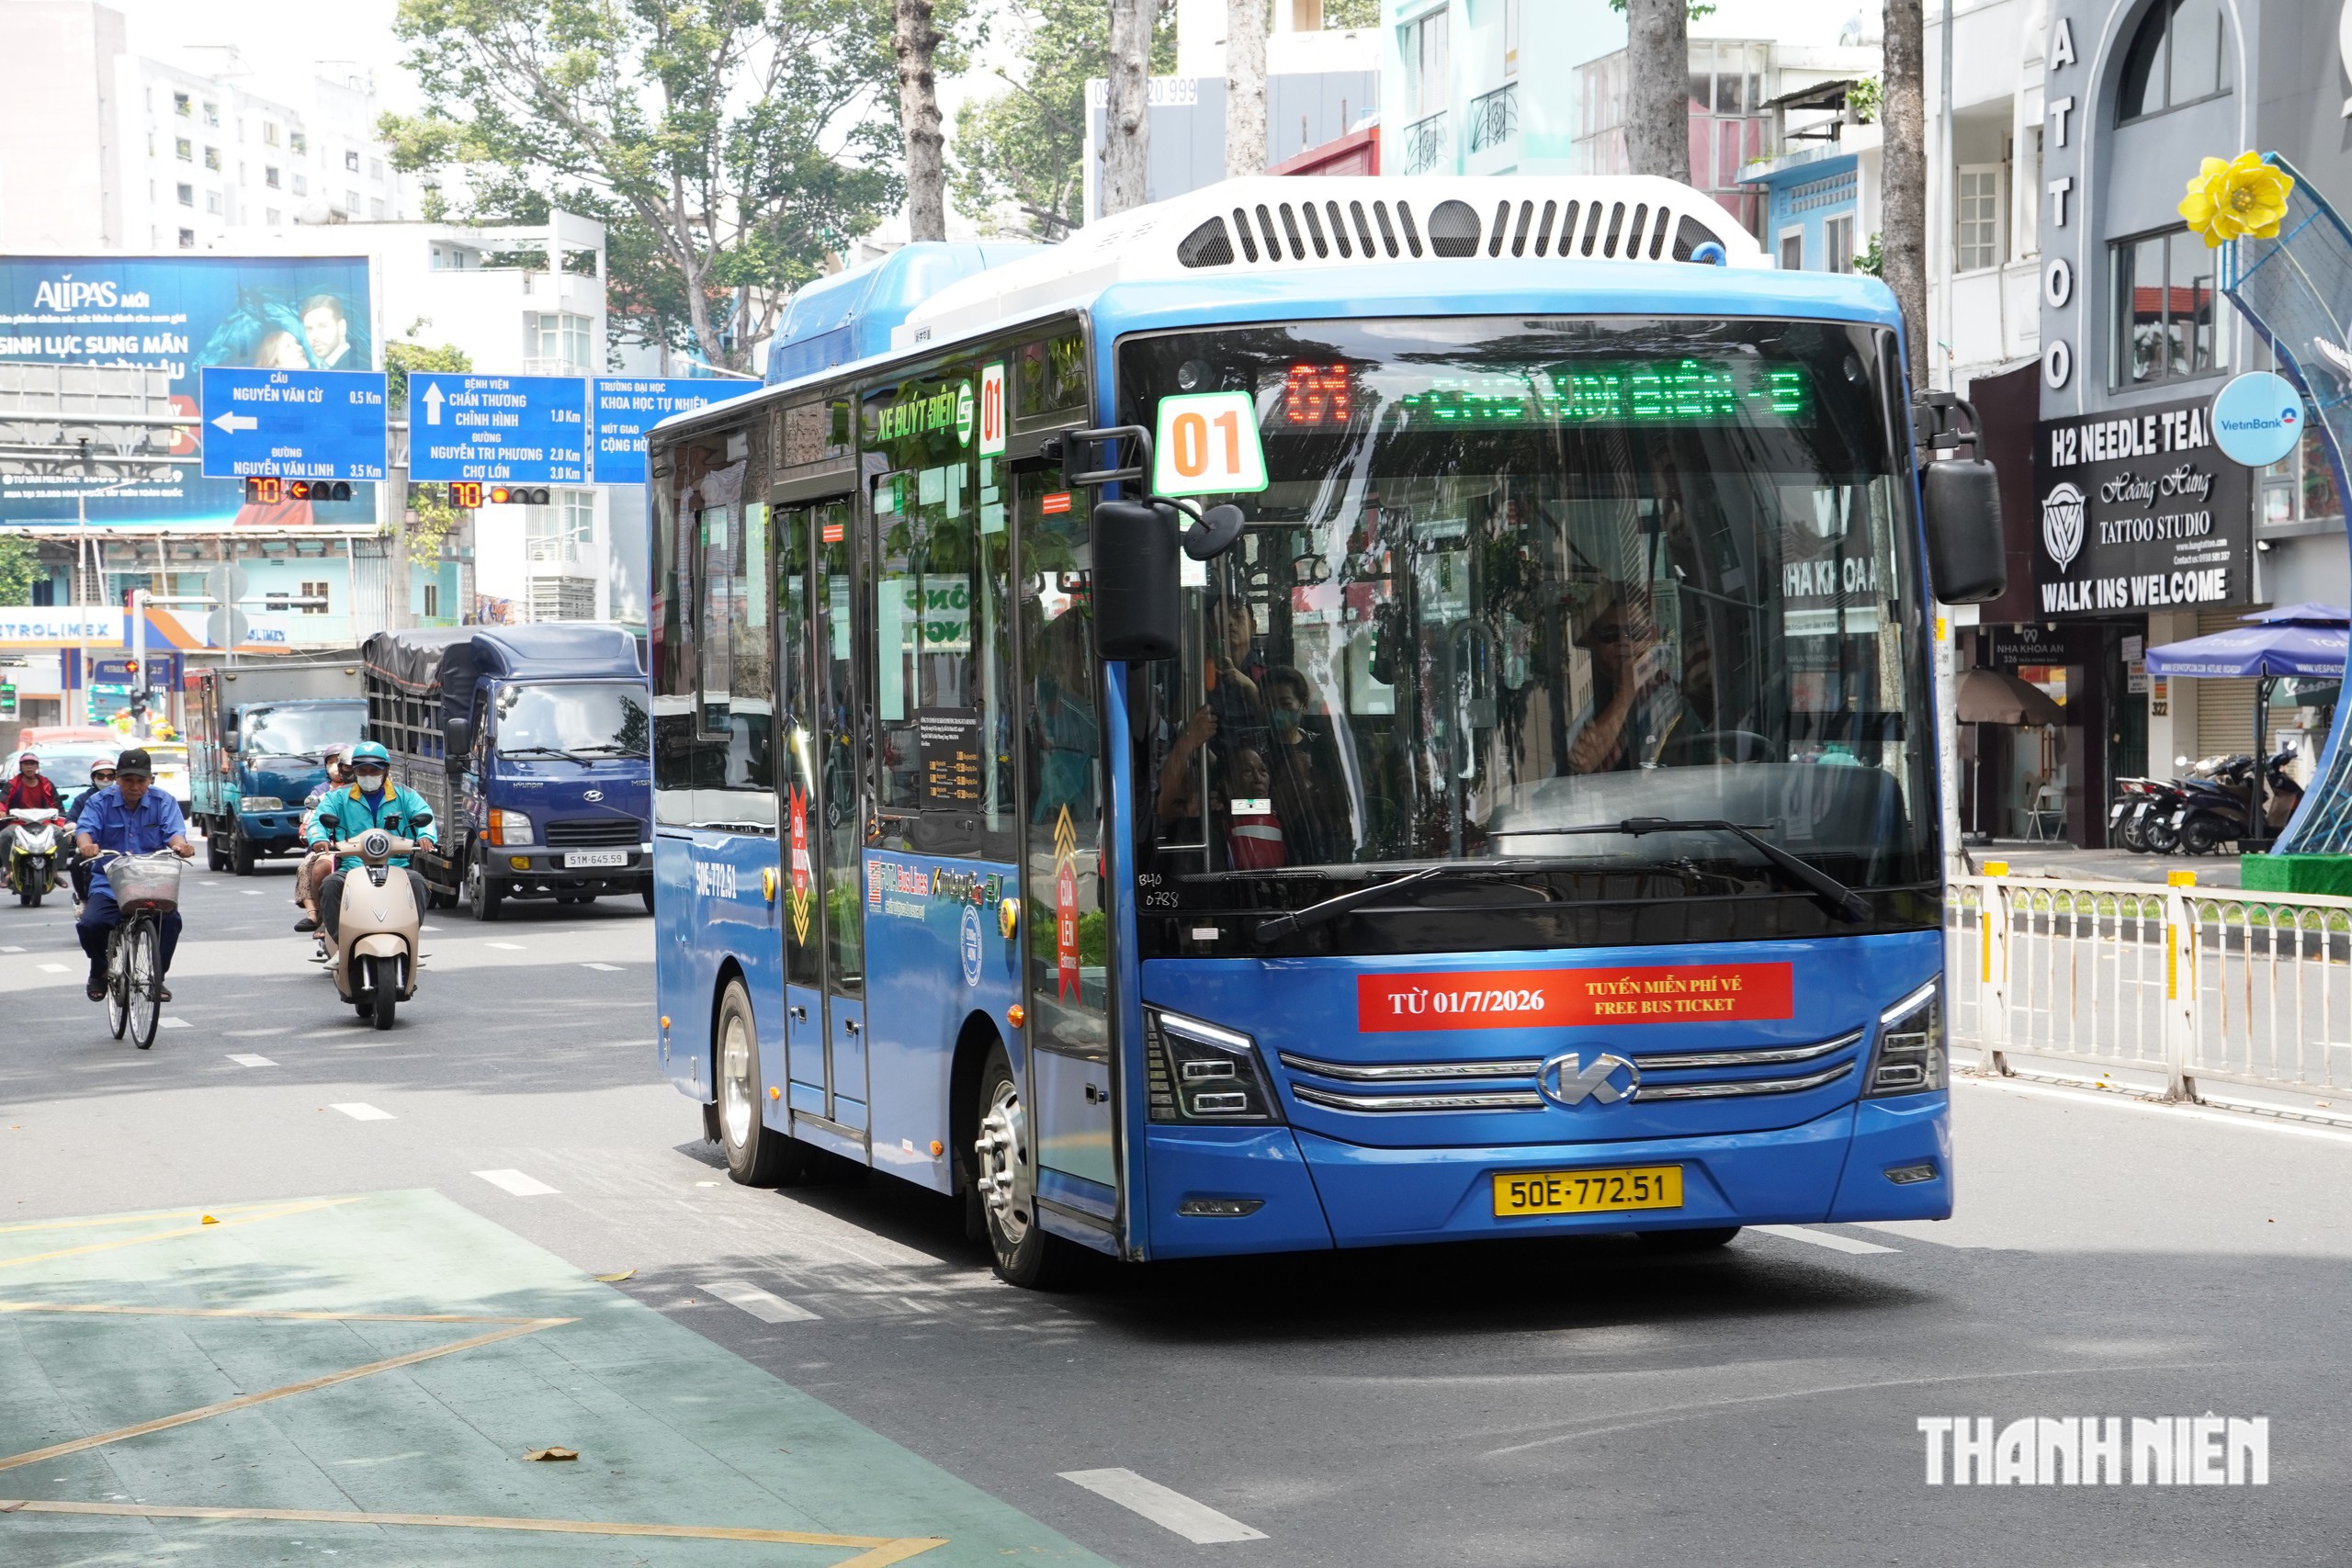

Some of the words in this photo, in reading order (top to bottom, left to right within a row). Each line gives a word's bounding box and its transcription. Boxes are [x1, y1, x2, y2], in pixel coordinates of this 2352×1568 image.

[1170, 78, 1196, 102] 999
[0, 336, 41, 355] SINH
[46, 334, 82, 358] LỰC
[85, 335, 138, 354] SUNG
[142, 332, 188, 354] MÃN
[270, 371, 288, 384] CẦU
[465, 378, 487, 390] BỆNH
[490, 378, 509, 390] VIỆN
[600, 380, 632, 392] TRƯỜNG
[634, 382, 648, 393] ĐẠI
[650, 383, 666, 393] HỌC
[233, 384, 279, 401] NGUYỄN
[282, 387, 305, 402] VĂN
[308, 387, 323, 403] CỪ
[349, 391, 364, 404] 0,5
[366, 391, 381, 404] Km
[449, 389, 479, 407] CHẤN
[481, 393, 526, 407] THƯƠNG
[1288, 365, 1347, 420] 01
[601, 396, 630, 410] KHOA
[632, 397, 654, 412] HỌC
[657, 397, 673, 412] TỰ
[674, 396, 708, 411] NHIÊN
[985, 378, 1001, 441] 01
[456, 410, 489, 426] CHỈNH
[492, 411, 518, 426] HÌNH
[550, 410, 563, 423] 1,0
[566, 411, 581, 423] Km
[877, 406, 893, 442] XE
[895, 391, 927, 437] BUÝT
[2221, 418, 2282, 430] VietinBank
[472, 431, 502, 443] ĐƯỜNG
[601, 423, 618, 434] NÚT
[620, 424, 639, 434] GIAO
[601, 437, 630, 453] CỘNG
[633, 436, 649, 452] HÒ
[1172, 411, 1240, 478] 01
[2052, 427, 2077, 468] H2
[2080, 415, 2157, 464] NEEDLE
[272, 446, 302, 458] ĐƯỜNG
[430, 443, 475, 459] NGUYỄN
[478, 446, 495, 460] TRI
[498, 447, 543, 461] PHƯƠNG
[550, 448, 563, 461] 2,0
[566, 448, 581, 462] Km
[233, 458, 280, 476] NGUYỄN
[283, 461, 305, 476] VĂN
[308, 463, 334, 476] LINH
[350, 465, 364, 478] 3,5
[367, 465, 381, 478] Km
[463, 465, 485, 480] CHỢ
[488, 463, 510, 479] LỚN
[550, 467, 563, 479] 3,0
[566, 467, 581, 479] Km
[249, 479, 278, 502] 70
[452, 483, 481, 507] 70
[2101, 471, 2157, 509] Hoàng
[2100, 517, 2154, 544] TATTOO
[2157, 511, 2211, 540] STUDIO
[2041, 580, 2093, 613] WALK
[2097, 577, 2128, 609] INS
[2131, 568, 2226, 606] WELCOME
[0, 623, 108, 637] TROLIMEX
[247, 629, 286, 642] OLIMEX
[1997, 645, 2018, 653] NHA
[2020, 645, 2048, 653] KHOA
[2050, 645, 2064, 653] AN
[2004, 655, 2018, 663] 326
[2296, 664, 2344, 673] WWW.VESPATO
[2152, 701, 2168, 717] 322
[570, 854, 622, 865] 51M-645.59
[696, 862, 737, 899] 50E-772.51
[1585, 976, 1641, 995] TUYẾN
[1645, 975, 1687, 994] MIỄN
[1690, 976, 1718, 993] PHÍ
[1721, 975, 1742, 991] VÉ
[1387, 987, 1429, 1014] TỪ
[1433, 989, 1545, 1013] 01/7/2026
[1594, 1001, 1637, 1015] FREE
[1642, 1000, 1672, 1014] BUS
[1675, 998, 1736, 1013] TICKET
[1510, 1175, 1664, 1208] 50E-772.51
